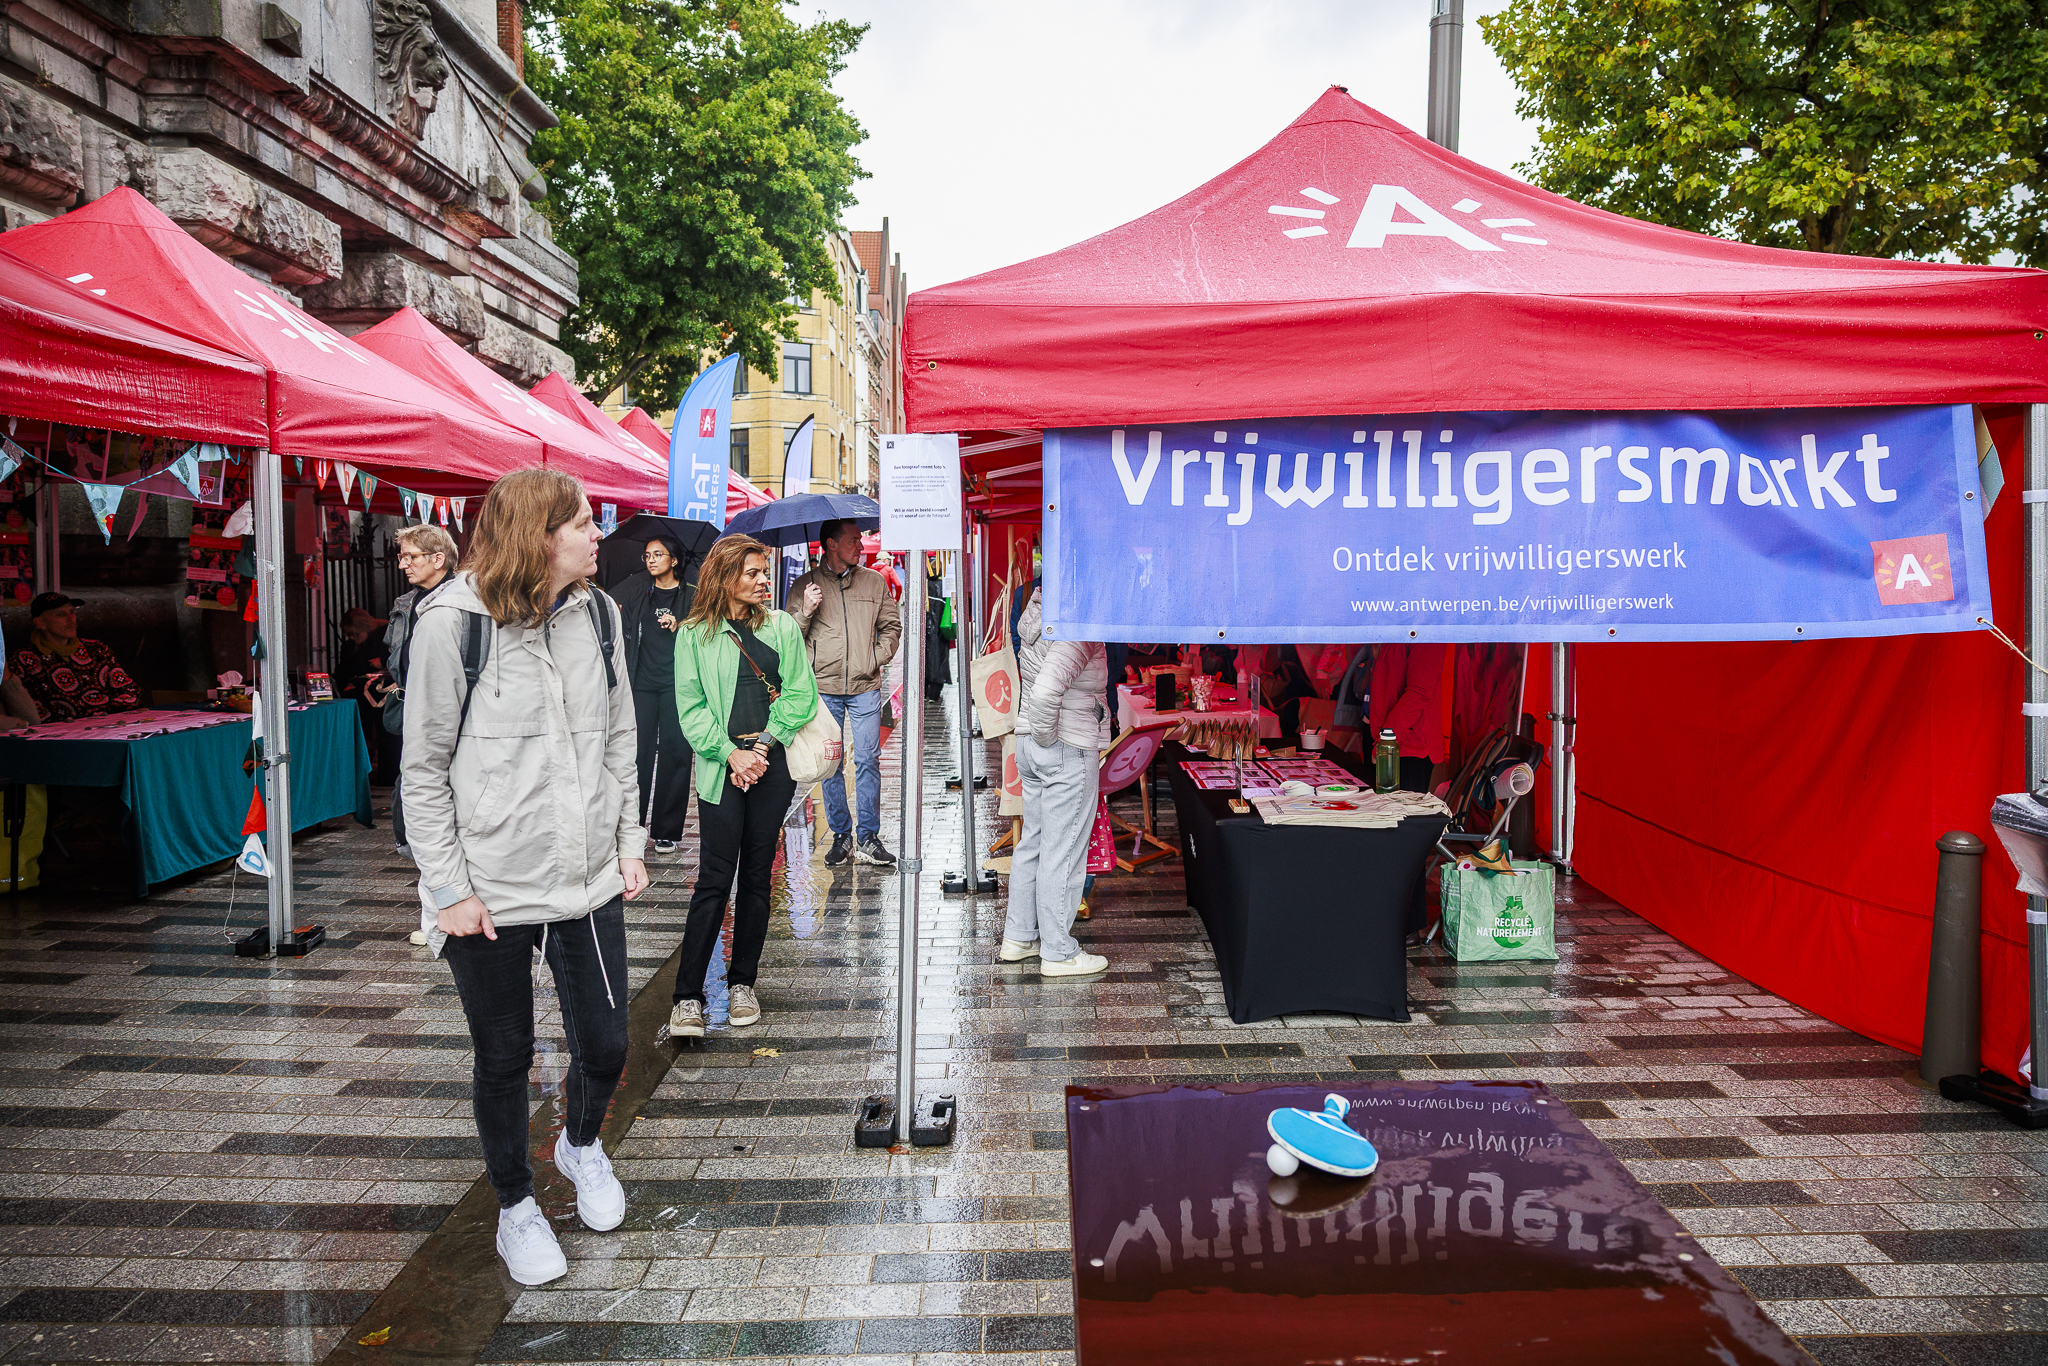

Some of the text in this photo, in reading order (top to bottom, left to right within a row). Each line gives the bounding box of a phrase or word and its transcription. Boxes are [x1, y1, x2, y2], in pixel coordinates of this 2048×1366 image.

[1346, 184, 1505, 252] A
[703, 415, 712, 431] A
[1111, 429, 1897, 526] Vrijwilligersmarkt
[1332, 542, 1687, 576] Ontdek vrijwilligerswerk
[1895, 553, 1932, 590] A
[1350, 593, 1675, 614] www.antwerpen.be/vrijwilligerswerk
[1494, 915, 1532, 928] RECYCLÉ,
